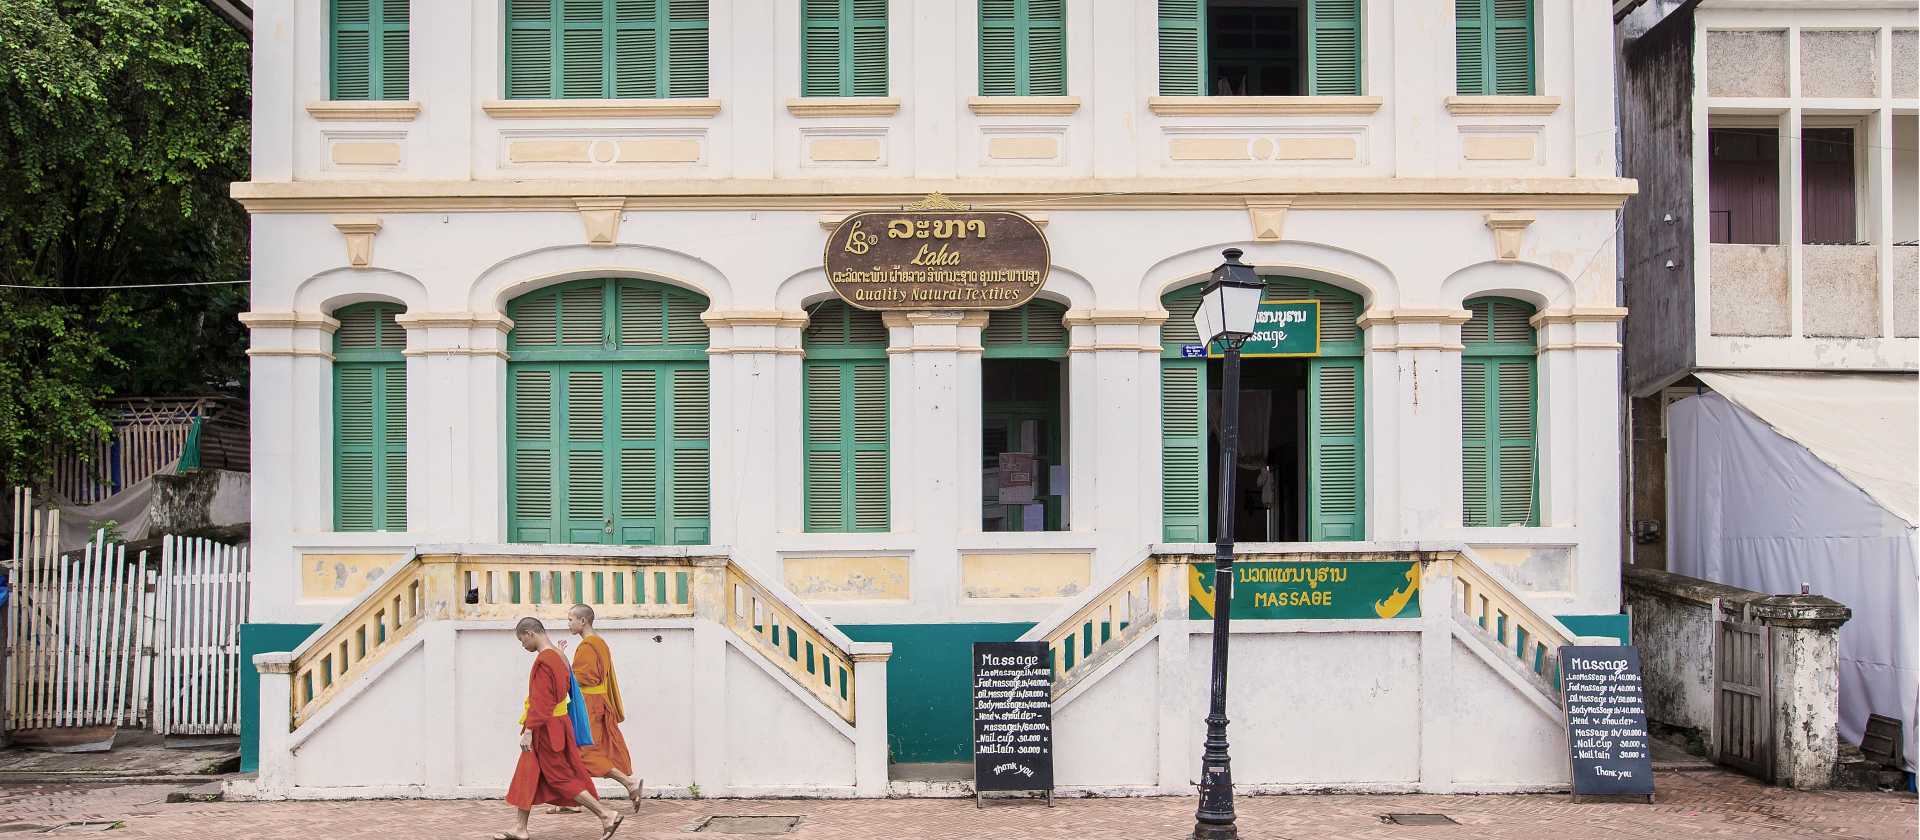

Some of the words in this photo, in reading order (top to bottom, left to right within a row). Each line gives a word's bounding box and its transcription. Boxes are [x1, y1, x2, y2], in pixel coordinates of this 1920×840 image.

[887, 218, 986, 239] ລະຫາ
[910, 243, 961, 266] Laha
[855, 287, 906, 303] Quality
[911, 287, 961, 301] Natural
[966, 287, 1020, 301] Textiles
[1254, 591, 1332, 608] MASSAGE
[982, 654, 1038, 670] Massage
[1571, 657, 1629, 675] Massage
